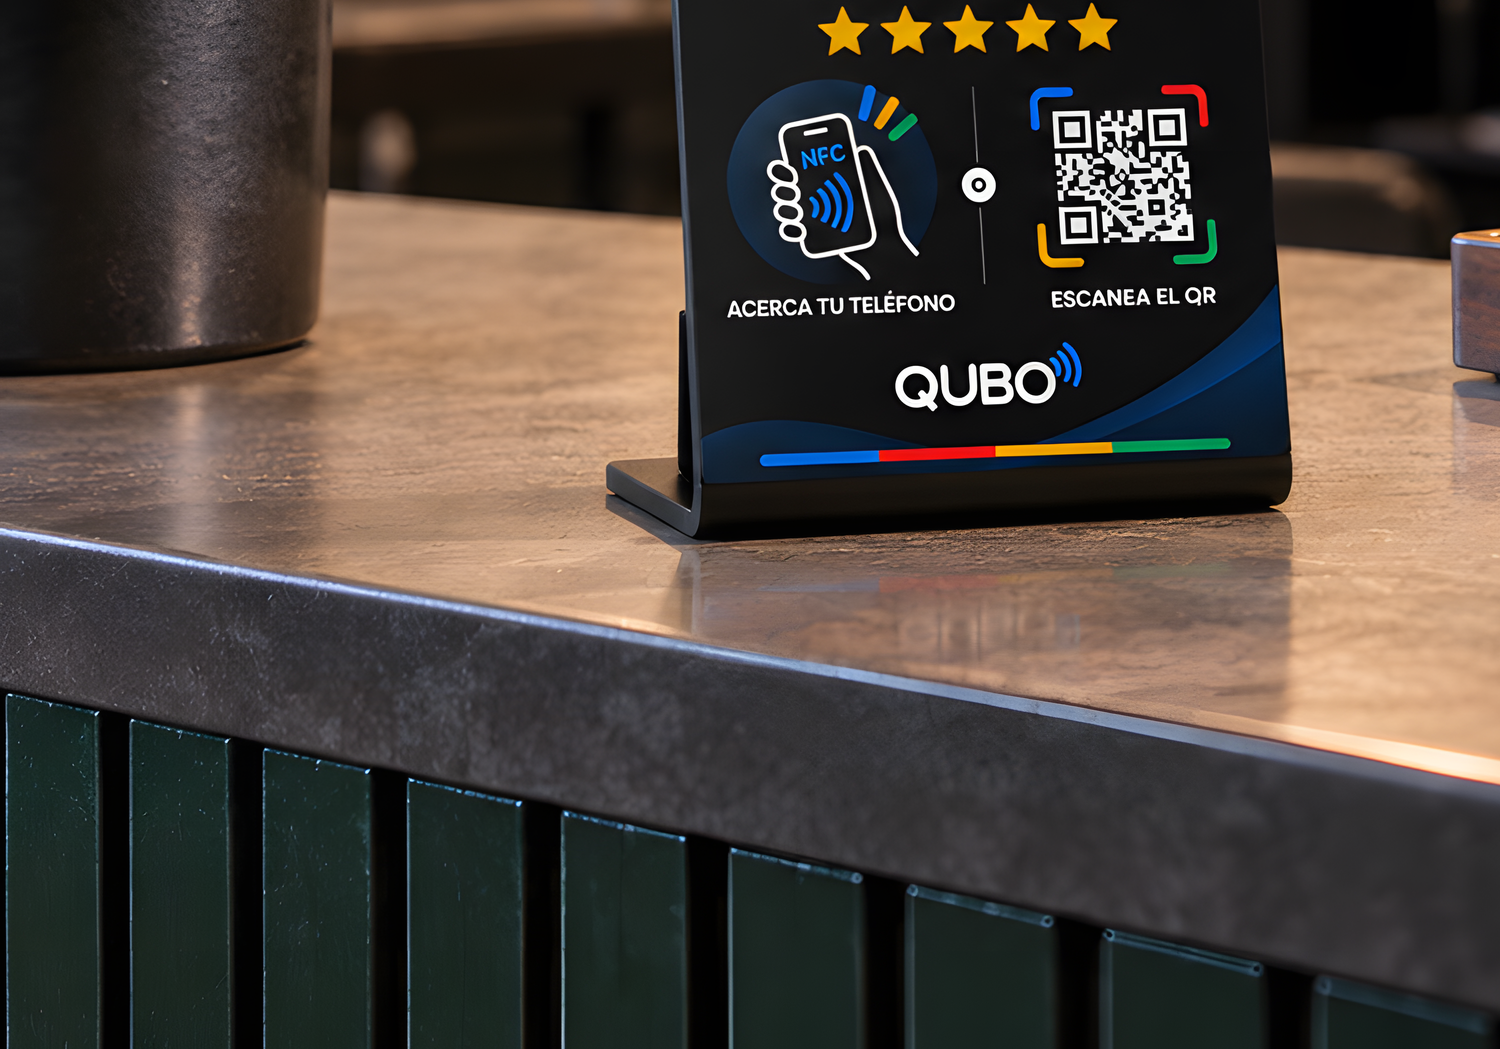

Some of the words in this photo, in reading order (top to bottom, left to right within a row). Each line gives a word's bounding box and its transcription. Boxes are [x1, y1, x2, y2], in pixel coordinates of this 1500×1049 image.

[801, 144, 845, 170] NFC
[727, 298, 813, 318] ACERCA
[816, 298, 843, 314] TU
[849, 290, 955, 313] TELÉFONO
[1052, 288, 1150, 308] ESCANEA
[1157, 288, 1180, 304] EL
[1185, 287, 1216, 306] QR
[895, 362, 1056, 411] QUBO
